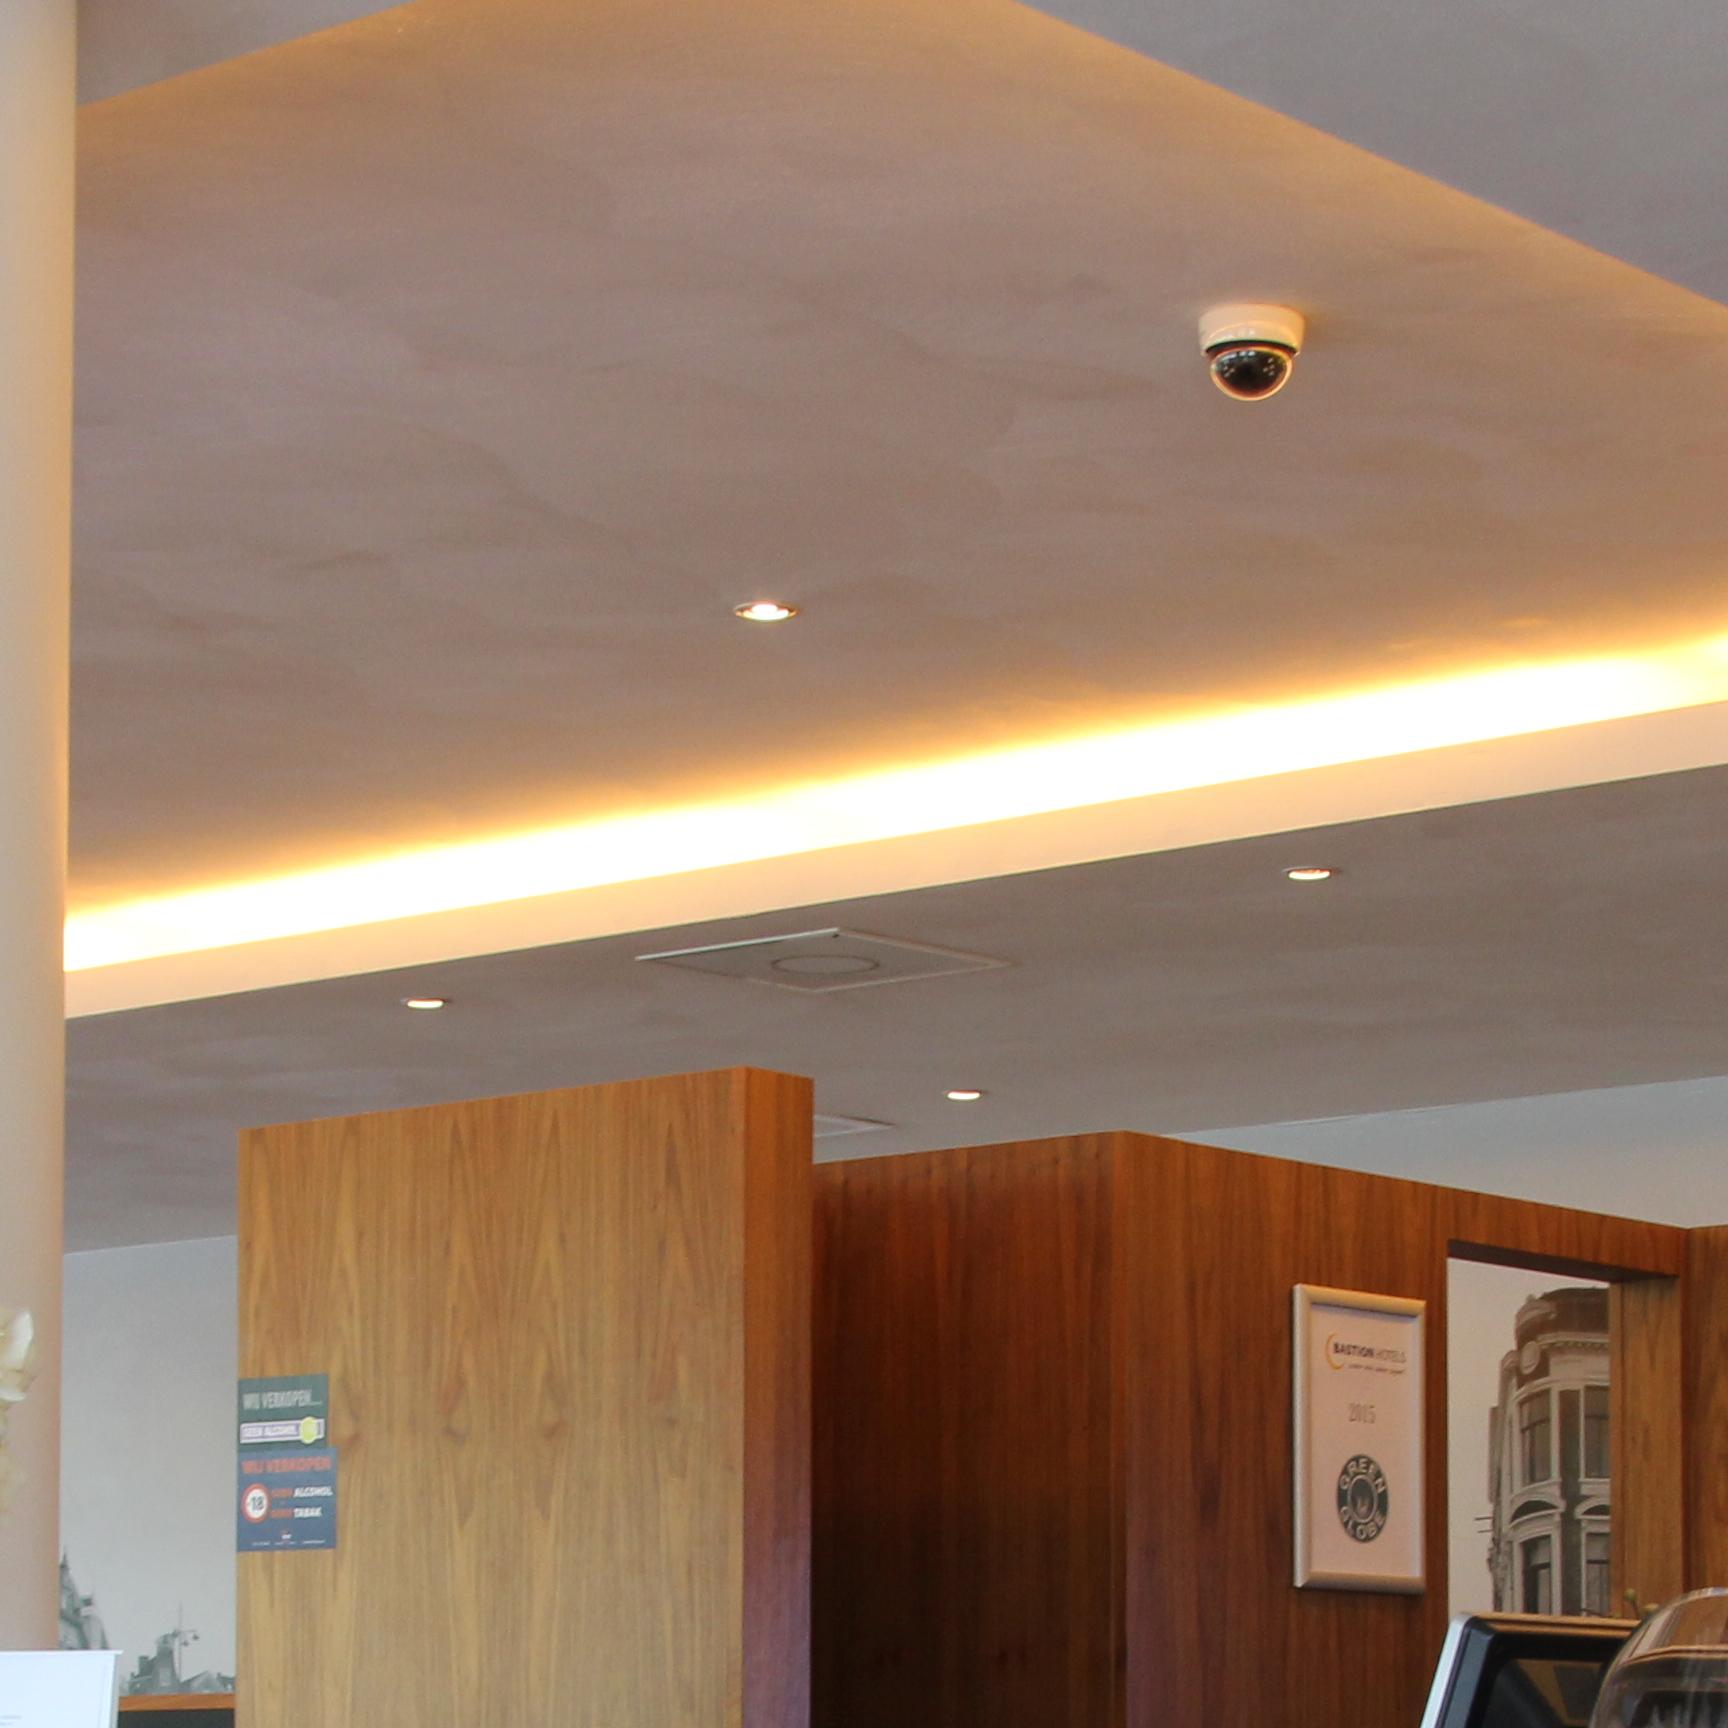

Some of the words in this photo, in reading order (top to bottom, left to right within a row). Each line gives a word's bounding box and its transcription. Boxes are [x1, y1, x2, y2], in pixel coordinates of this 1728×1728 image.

[1333, 1342, 1375, 1359] BASTION
[1348, 1402, 1376, 1424] 2015
[1339, 1457, 1387, 1494] GREEN
[1339, 1506, 1385, 1540] GLOBE
